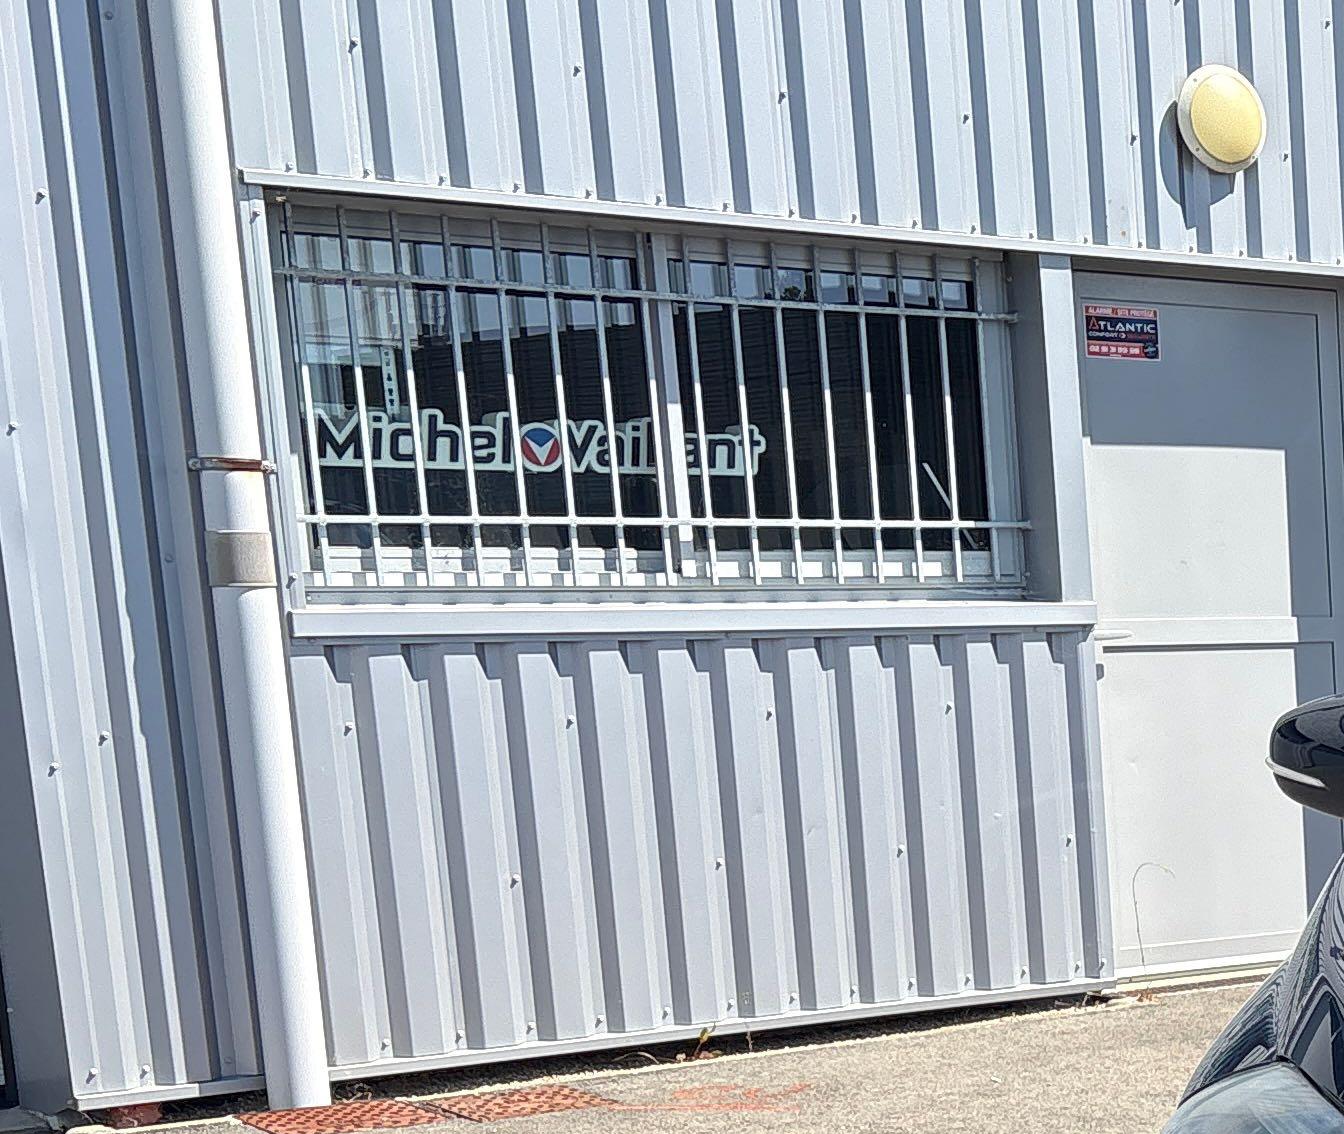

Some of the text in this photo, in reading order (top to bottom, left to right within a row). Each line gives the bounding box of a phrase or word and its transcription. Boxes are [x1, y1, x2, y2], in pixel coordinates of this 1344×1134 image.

[1088, 316, 1156, 334] ATLANTIC
[316, 412, 763, 472] Michel Vailant
